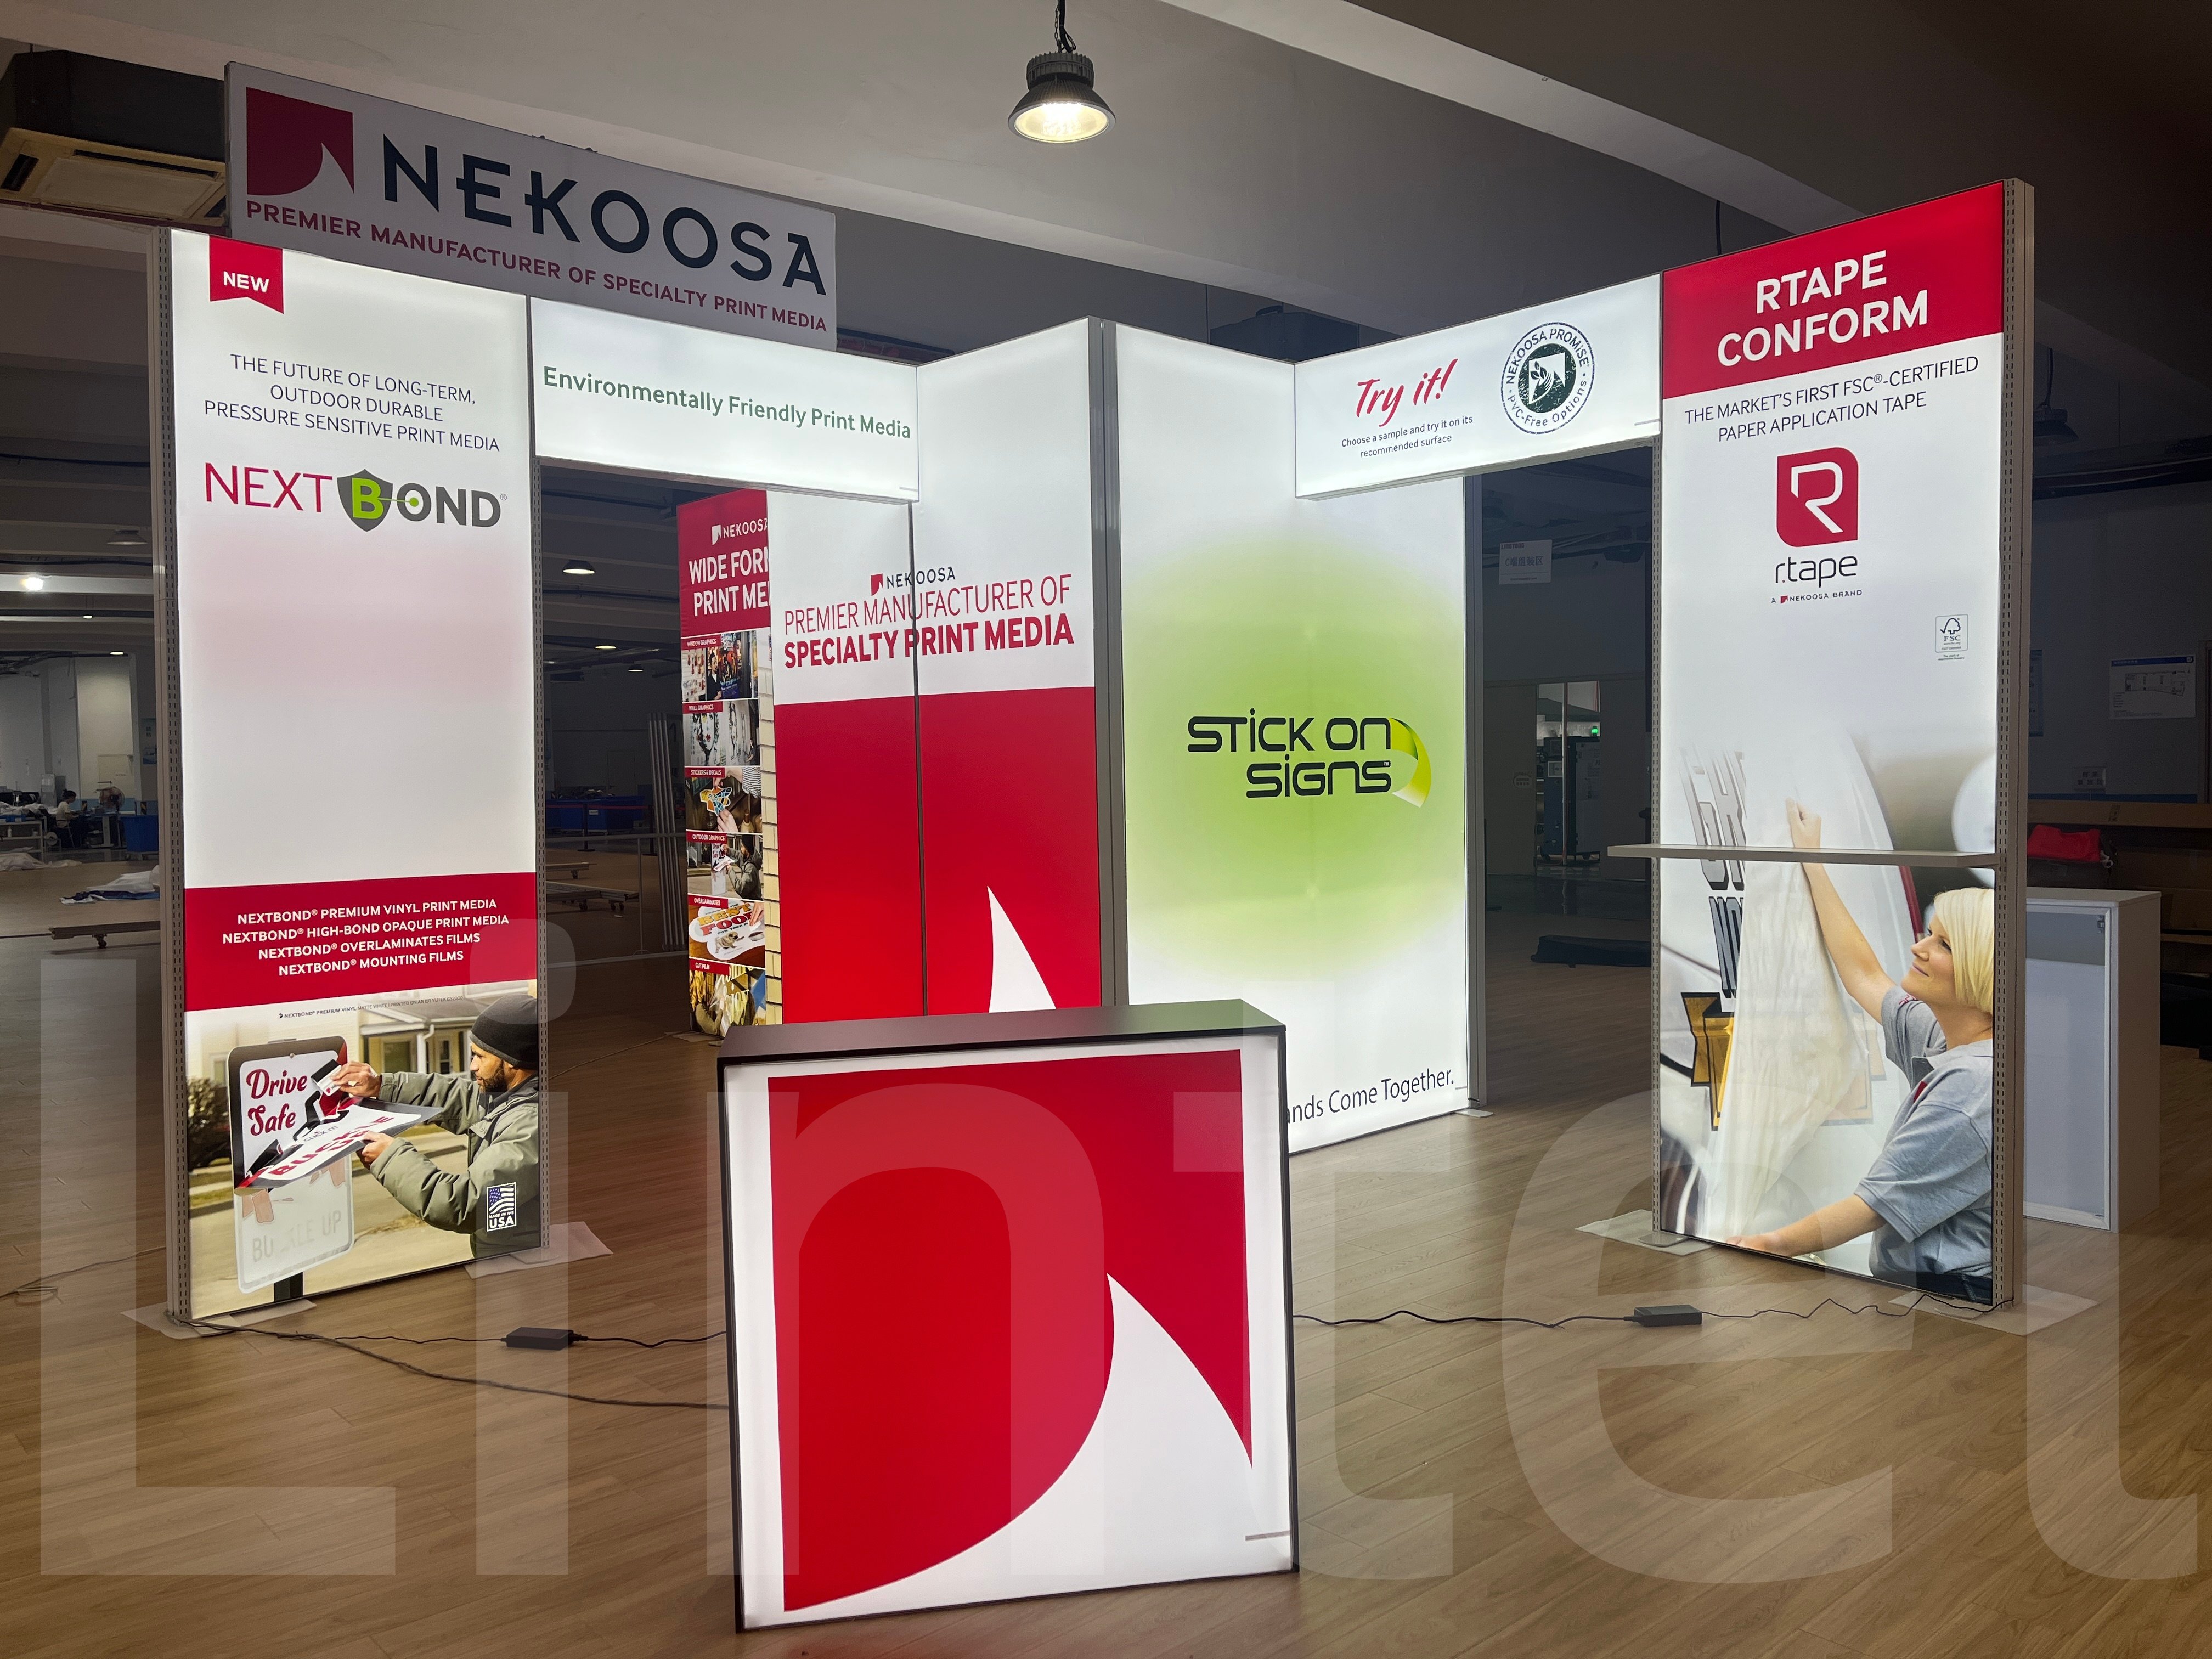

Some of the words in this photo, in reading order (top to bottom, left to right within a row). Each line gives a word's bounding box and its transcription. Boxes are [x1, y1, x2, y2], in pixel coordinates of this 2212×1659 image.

[383, 133, 827, 296] NEKOOSA
[223, 270, 269, 293] NEW
[246, 200, 361, 239] PREMIER
[371, 224, 561, 279] MANUFACTURER
[568, 266, 596, 285] OF
[603, 274, 707, 308] SPECIALTY
[714, 296, 768, 319] PRINT
[772, 309, 827, 332] MEDIA
[1756, 250, 1886, 314] RTAPE
[1718, 290, 1928, 366] CONFORM
[1506, 331, 1547, 384] NEKOOSA
[230, 354, 268, 374] THE
[273, 360, 343, 385] FUTURE
[348, 372, 371, 387] OF
[376, 376, 476, 405] LONG-TERM,
[1356, 379, 1404, 427] Try
[1413, 358, 1458, 405] it!
[270, 385, 360, 410] OUTDOOR
[366, 398, 443, 421] DURABLE
[543, 366, 723, 416] Environmentally
[729, 396, 806, 428] Friendly
[811, 408, 855, 431] Print
[860, 416, 911, 439] Media
[1552, 380, 1587, 423] Options
[1685, 405, 1714, 424] THE
[1796, 382, 1839, 406] FIRST
[1719, 420, 1766, 442] PAPER
[1770, 400, 1878, 434] APPLICATION
[1883, 391, 1927, 413] TAPE
[205, 400, 300, 426] PRESSURE
[304, 414, 393, 438] SENSITIVE
[398, 425, 445, 444] PRINT
[450, 433, 500, 451] MEDIA
[1342, 436, 1370, 447] Choose
[1379, 428, 1408, 441] sample
[1410, 424, 1425, 435] and
[1427, 422, 1440, 432] try
[1441, 420, 1447, 428] it
[1449, 418, 1460, 426] on
[1462, 415, 1473, 425] its
[1361, 440, 1419, 458] recommended
[1421, 434, 1452, 447] surface
[689, 553, 728, 585] WIDE
[887, 566, 956, 589] NEKOOSA
[693, 585, 739, 617] PRINT
[742, 580, 770, 610] ME
[785, 602, 859, 635] PREMIER
[864, 579, 1034, 626] MANUFACTURER
[1040, 573, 1072, 606] OF
[1790, 593, 1829, 602] NEKOOSA
[1832, 590, 1863, 598] BRAND
[785, 630, 899, 669] SPECIALTY
[905, 622, 979, 657] PRINT
[986, 613, 1074, 651] MEDIA
[307, 922, 380, 938] HIGH-BOND
[383, 919, 433, 934] OPAQUE
[436, 916, 470, 929] PRINT
[473, 915, 509, 926] MEDIA
[321, 905, 380, 919] PREMIUM
[383, 902, 420, 916] VINYL
[422, 901, 457, 913] PRINT
[460, 899, 497, 911] MEDIA
[697, 902, 752, 926] BEST
[340, 935, 444, 953] OVERLAMINATES
[446, 933, 481, 945] FILMS
[359, 953, 427, 969] MOUNTING
[429, 950, 464, 963] FILMS
[246, 1069, 308, 1099] Drive
[1329, 1090, 1378, 1113] Come
[1381, 1068, 1454, 1102] Together.
[247, 1103, 296, 1136] Safe
[489, 1215, 514, 1228] USA
